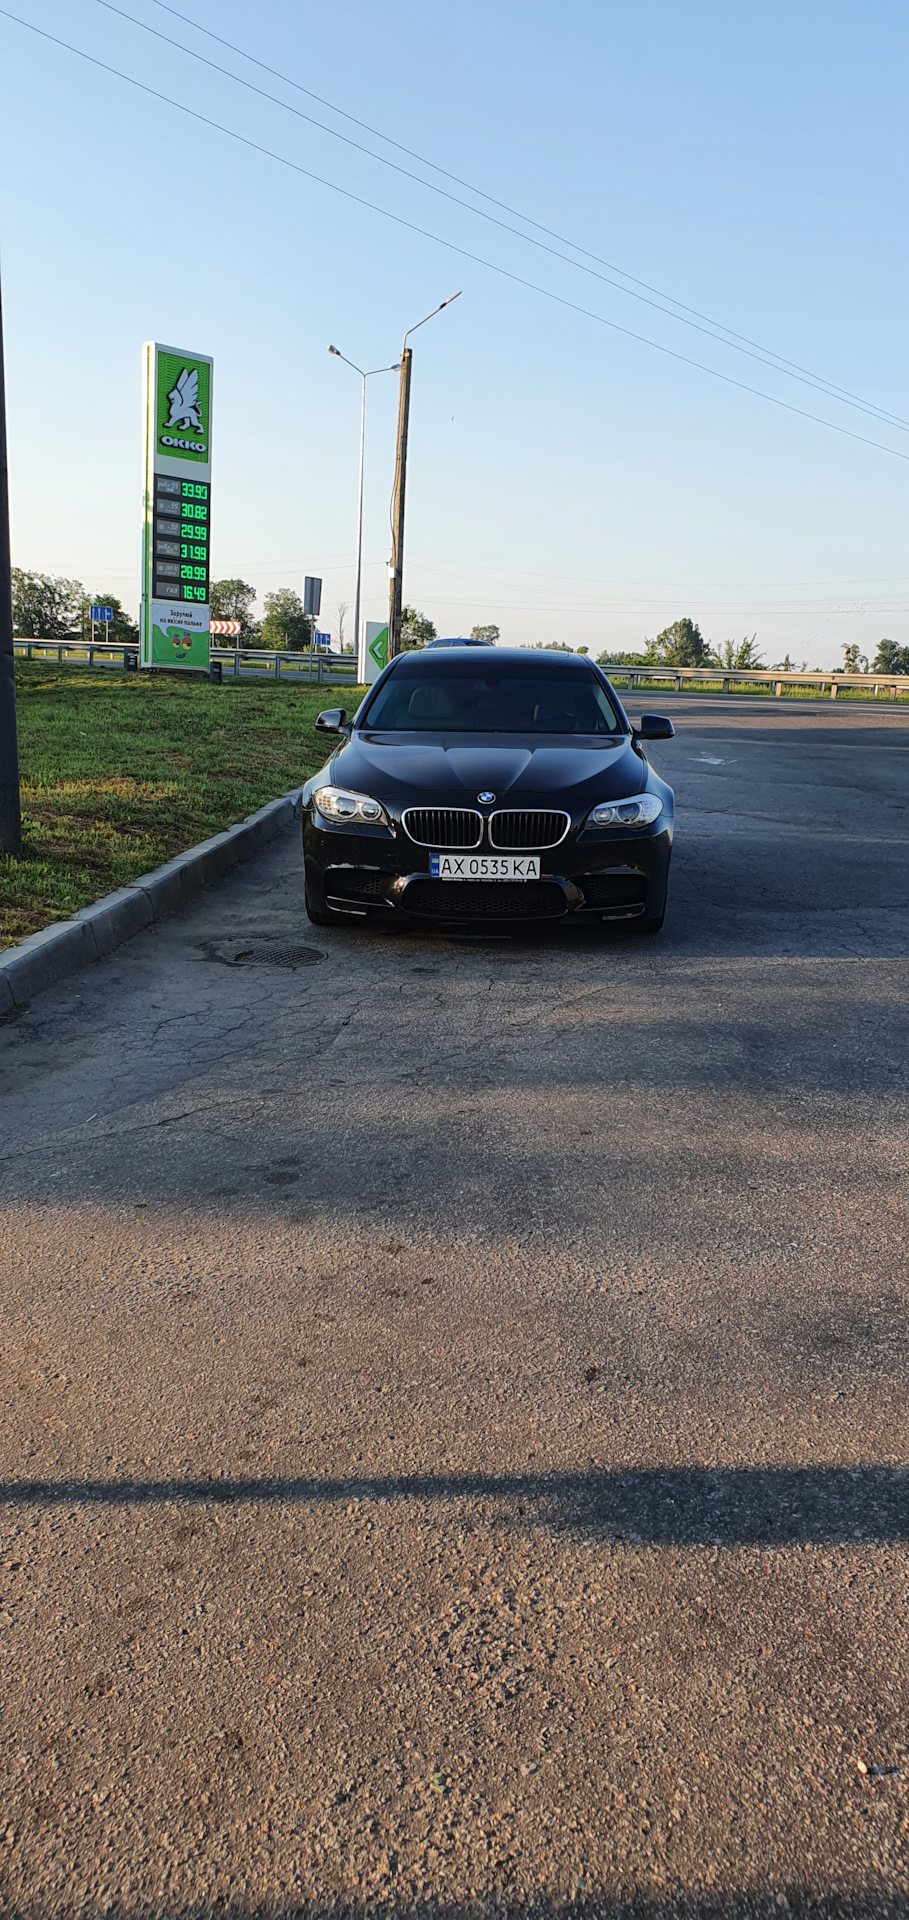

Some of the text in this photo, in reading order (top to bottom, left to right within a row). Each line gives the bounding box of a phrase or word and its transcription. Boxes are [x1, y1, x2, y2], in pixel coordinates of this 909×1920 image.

[161, 435, 207, 452] OKKO
[181, 502, 208, 520] 30.82
[181, 523, 207, 541] 29.99
[180, 544, 207, 561] 31.99
[180, 564, 207, 581] 28.99
[182, 585, 206, 601] 16.49
[441, 858, 537, 876] AX 0535 KA
